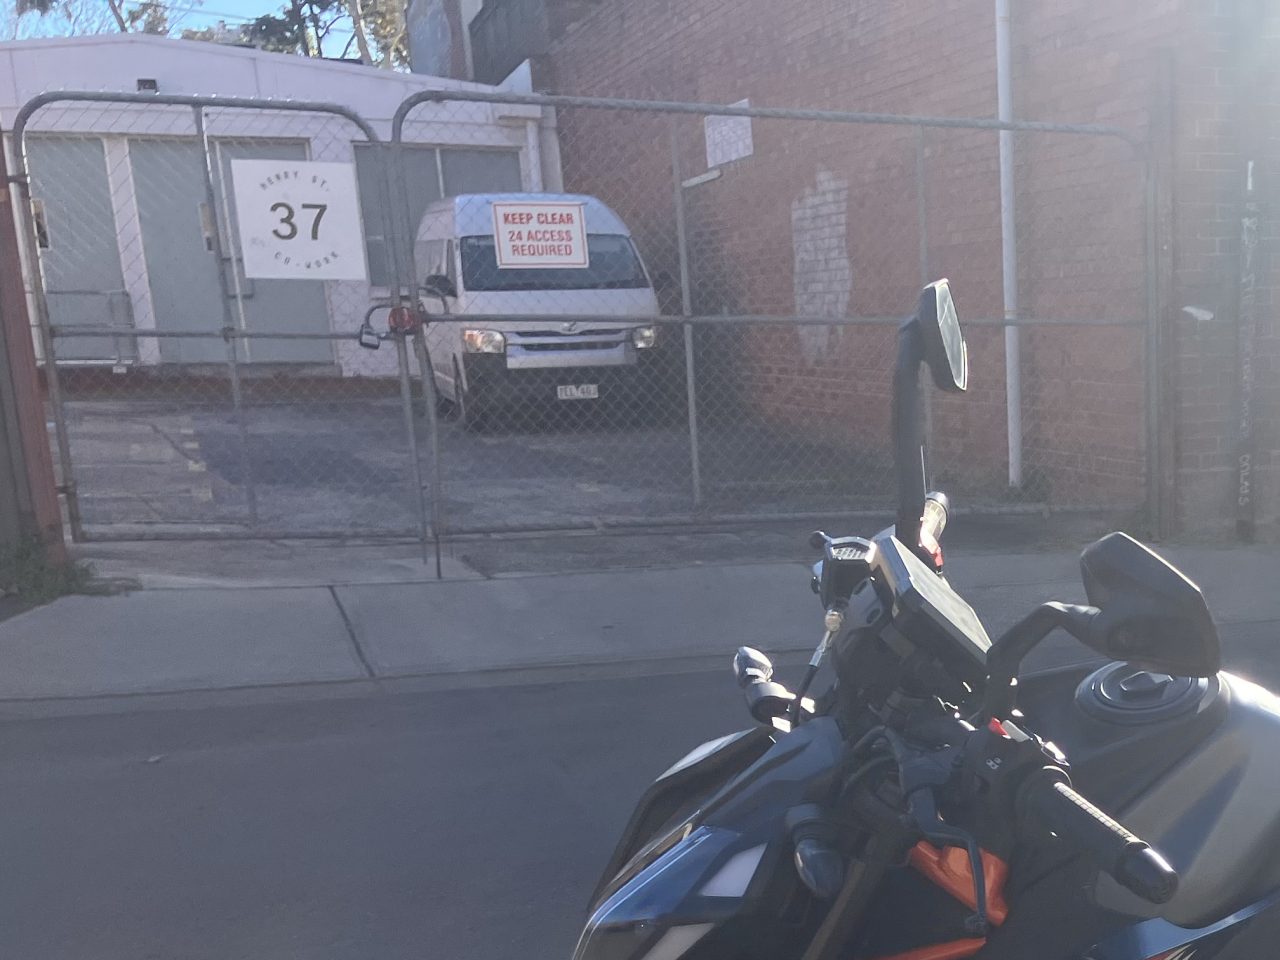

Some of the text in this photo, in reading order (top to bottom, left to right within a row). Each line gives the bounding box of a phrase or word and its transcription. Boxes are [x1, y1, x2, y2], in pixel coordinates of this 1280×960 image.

[270, 202, 328, 241] 37
[504, 213, 574, 225] KEEP CLEAR
[508, 230, 573, 242] 24 ACCESS
[512, 244, 573, 256] REQUIRED
